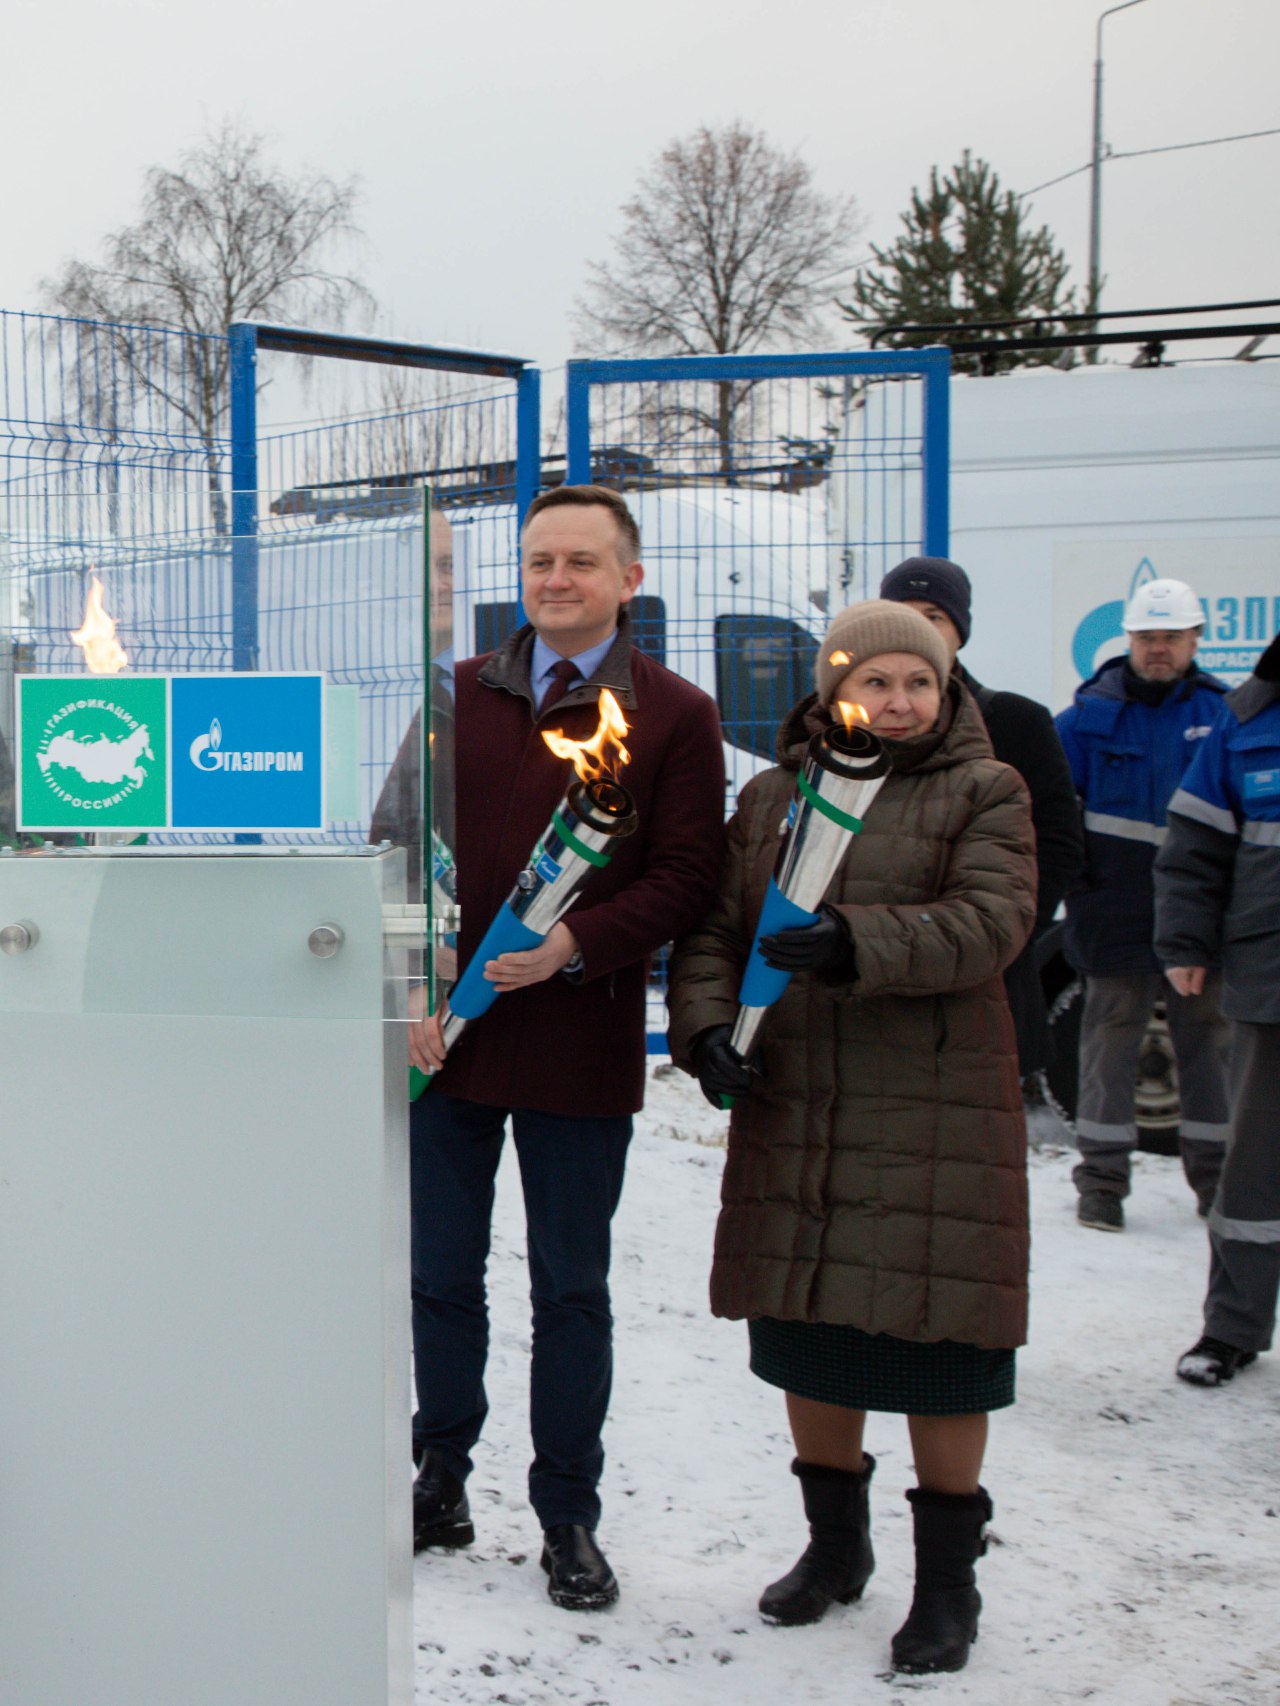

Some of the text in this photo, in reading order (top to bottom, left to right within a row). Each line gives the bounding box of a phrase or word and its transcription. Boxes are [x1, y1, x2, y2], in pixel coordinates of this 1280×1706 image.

[46, 698, 139, 729] ГАЗИФИКАЦИЯ
[223, 751, 304, 772] ГАЗПРОМ
[62, 793, 123, 810] РОССИИ
